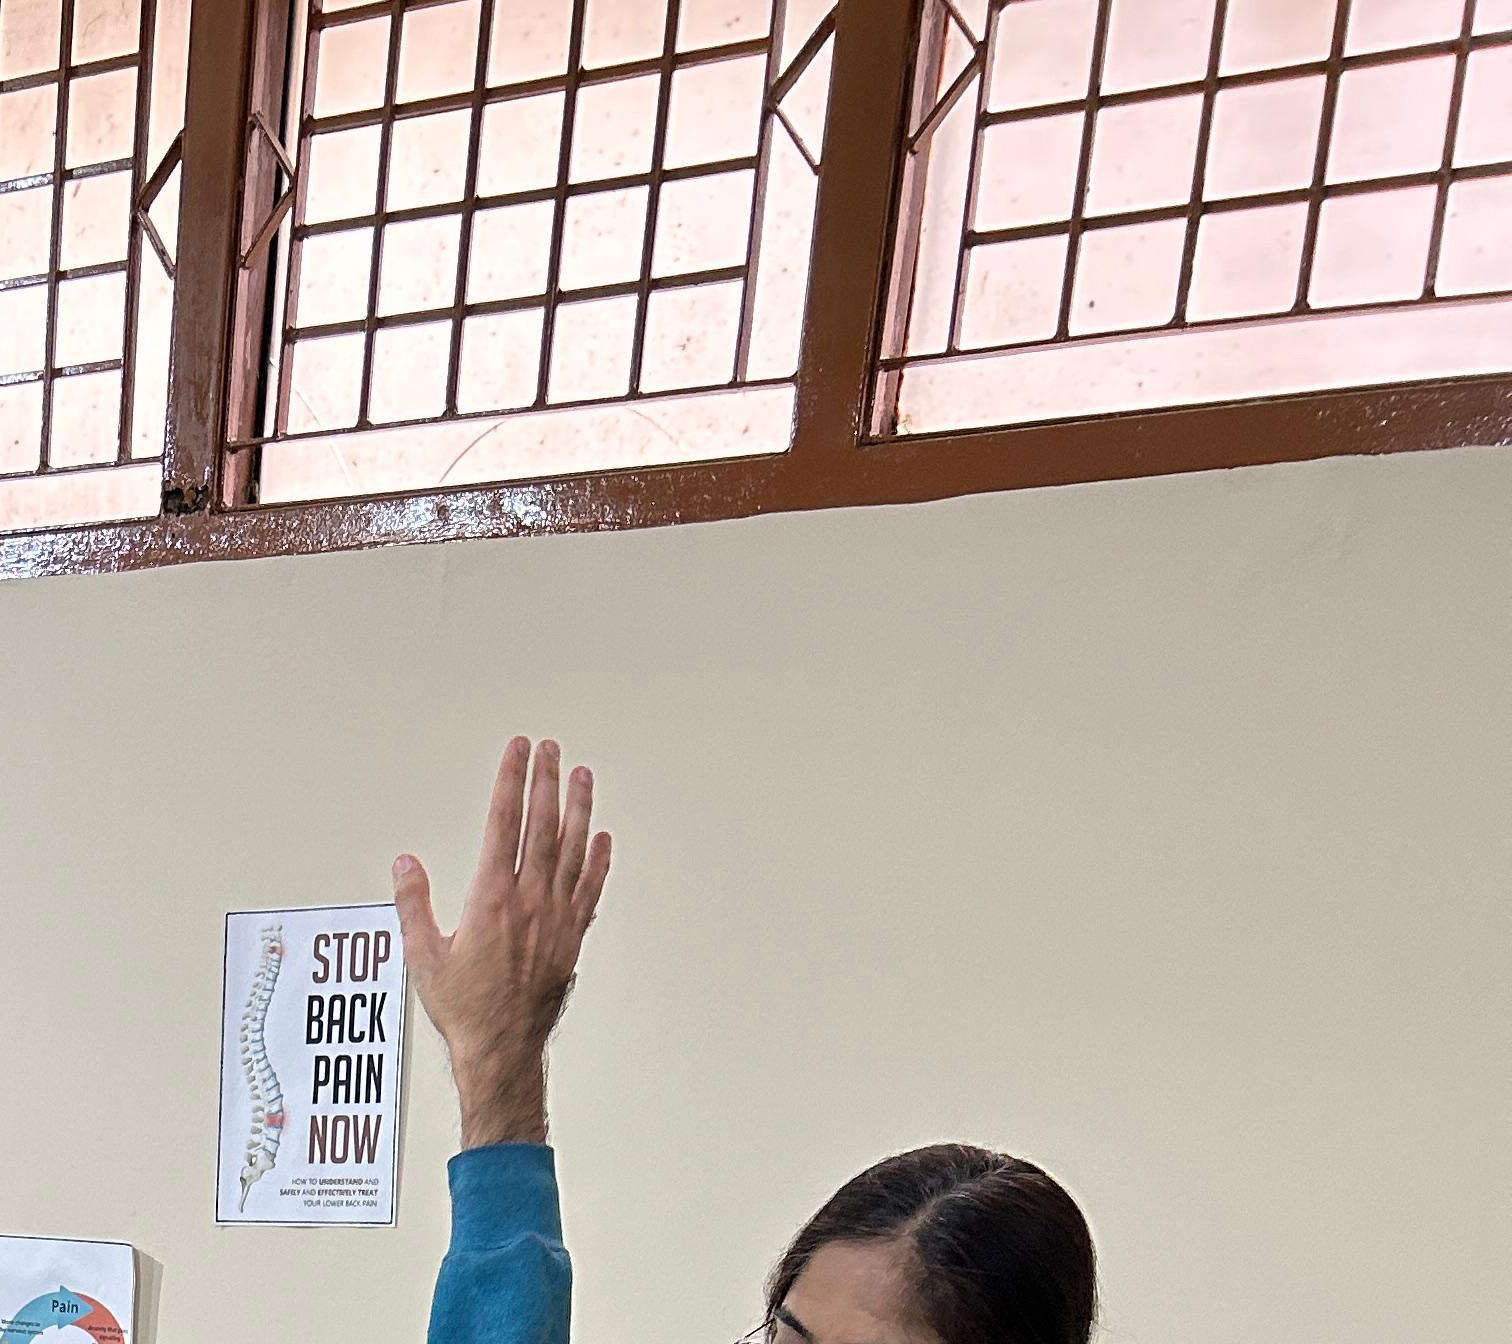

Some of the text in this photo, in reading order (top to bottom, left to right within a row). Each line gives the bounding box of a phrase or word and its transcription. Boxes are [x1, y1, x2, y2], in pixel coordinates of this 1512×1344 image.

[312, 930, 391, 984] STOP
[305, 992, 387, 1045] BACK
[312, 1053, 384, 1105] PAIN
[308, 1114, 383, 1164] NOW
[279, 1188, 301, 1197] SAFELY
[357, 1188, 379, 1197] TREAT
[308, 1178, 318, 1186] TO
[51, 1299, 79, 1314] Pain
